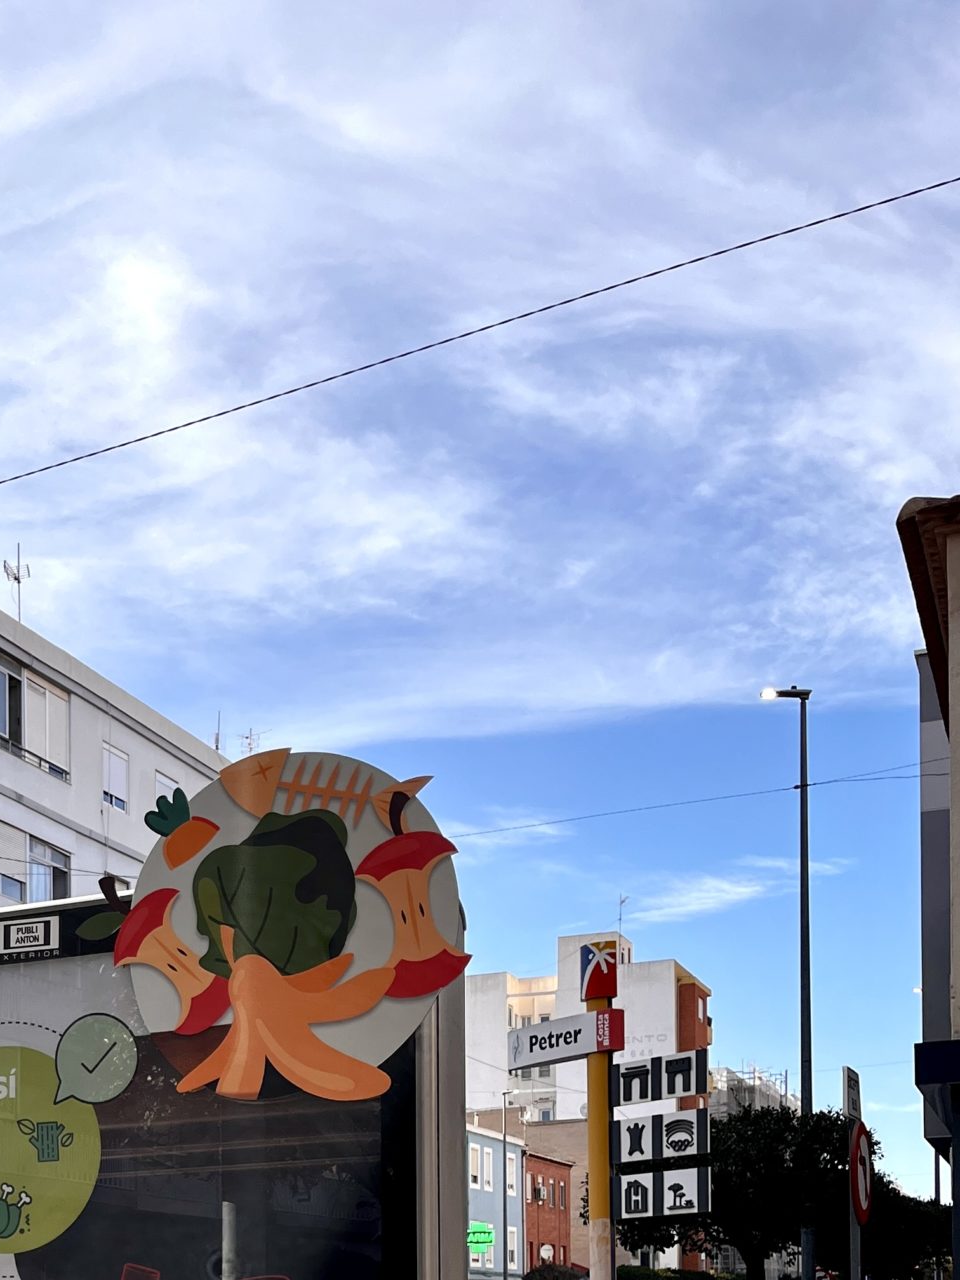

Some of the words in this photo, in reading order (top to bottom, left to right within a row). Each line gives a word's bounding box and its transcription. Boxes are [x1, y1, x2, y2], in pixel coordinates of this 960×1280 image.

[16, 925, 38, 935] PUBLI
[15, 934, 39, 945] ANTON
[529, 1027, 582, 1053] Petrer
